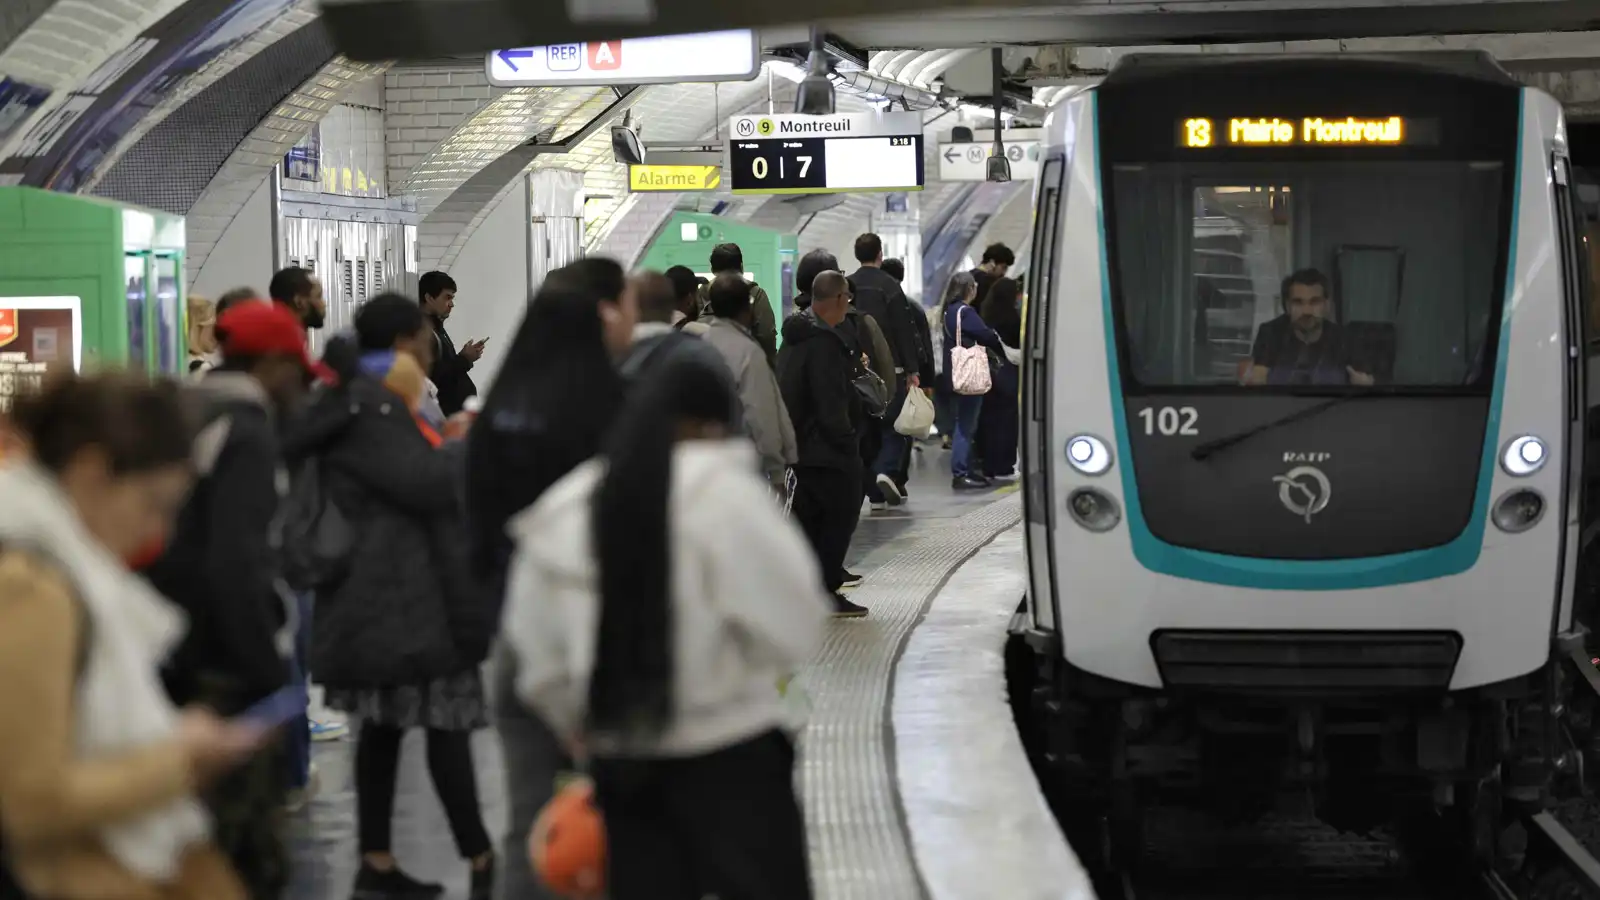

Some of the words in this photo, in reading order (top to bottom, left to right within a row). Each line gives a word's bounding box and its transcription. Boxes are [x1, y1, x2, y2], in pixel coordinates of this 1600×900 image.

[551, 46, 577, 61] RER
[596, 42, 614, 64] A
[780, 118, 851, 133] Montreuil
[1185, 118, 1211, 147] 13
[638, 172, 697, 185] Alarme
[752, 156, 768, 179] 0
[796, 156, 812, 178] 7
[1138, 406, 1199, 436] 102
[1283, 451, 1331, 463] RATP
